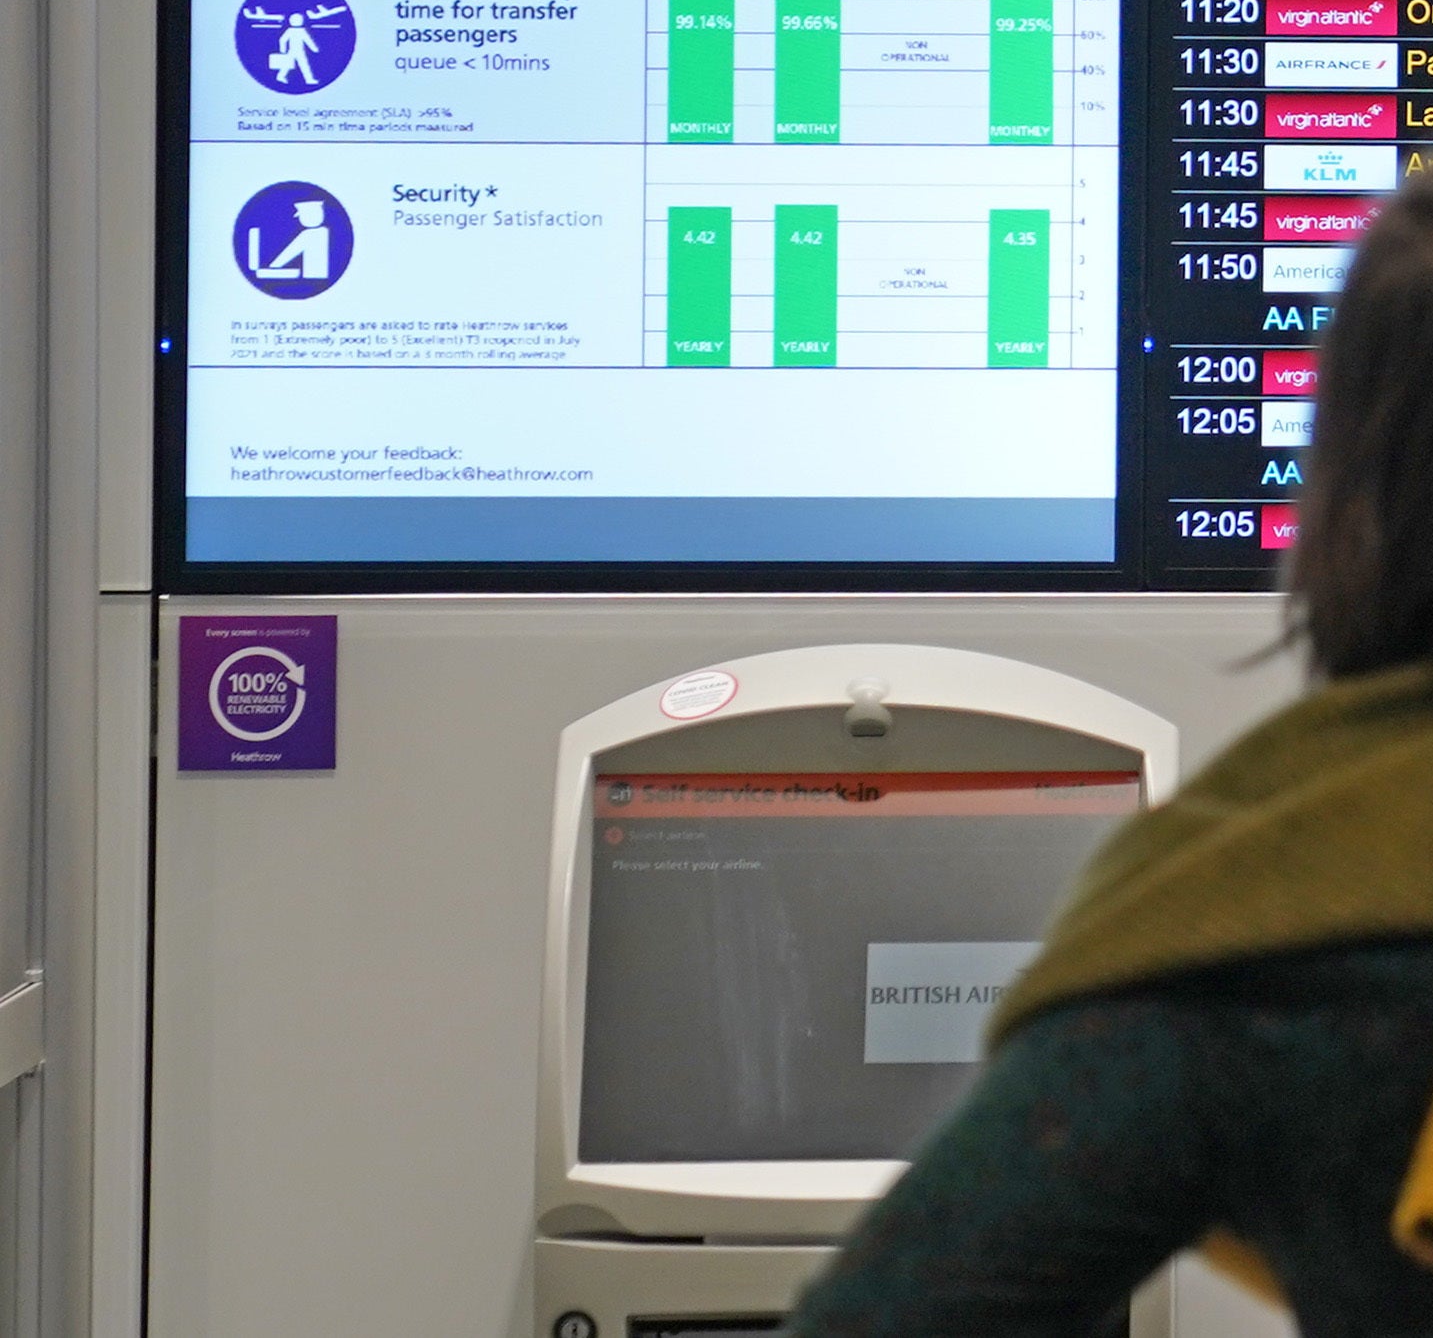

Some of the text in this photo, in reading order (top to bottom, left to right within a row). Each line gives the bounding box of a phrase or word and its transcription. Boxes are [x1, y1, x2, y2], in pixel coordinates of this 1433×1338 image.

[395, 0, 577, 20] time for transfer
[397, 29, 517, 47] passengers
[231, 446, 461, 464] We welcome your feedback:
[228, 673, 288, 693] 100%
